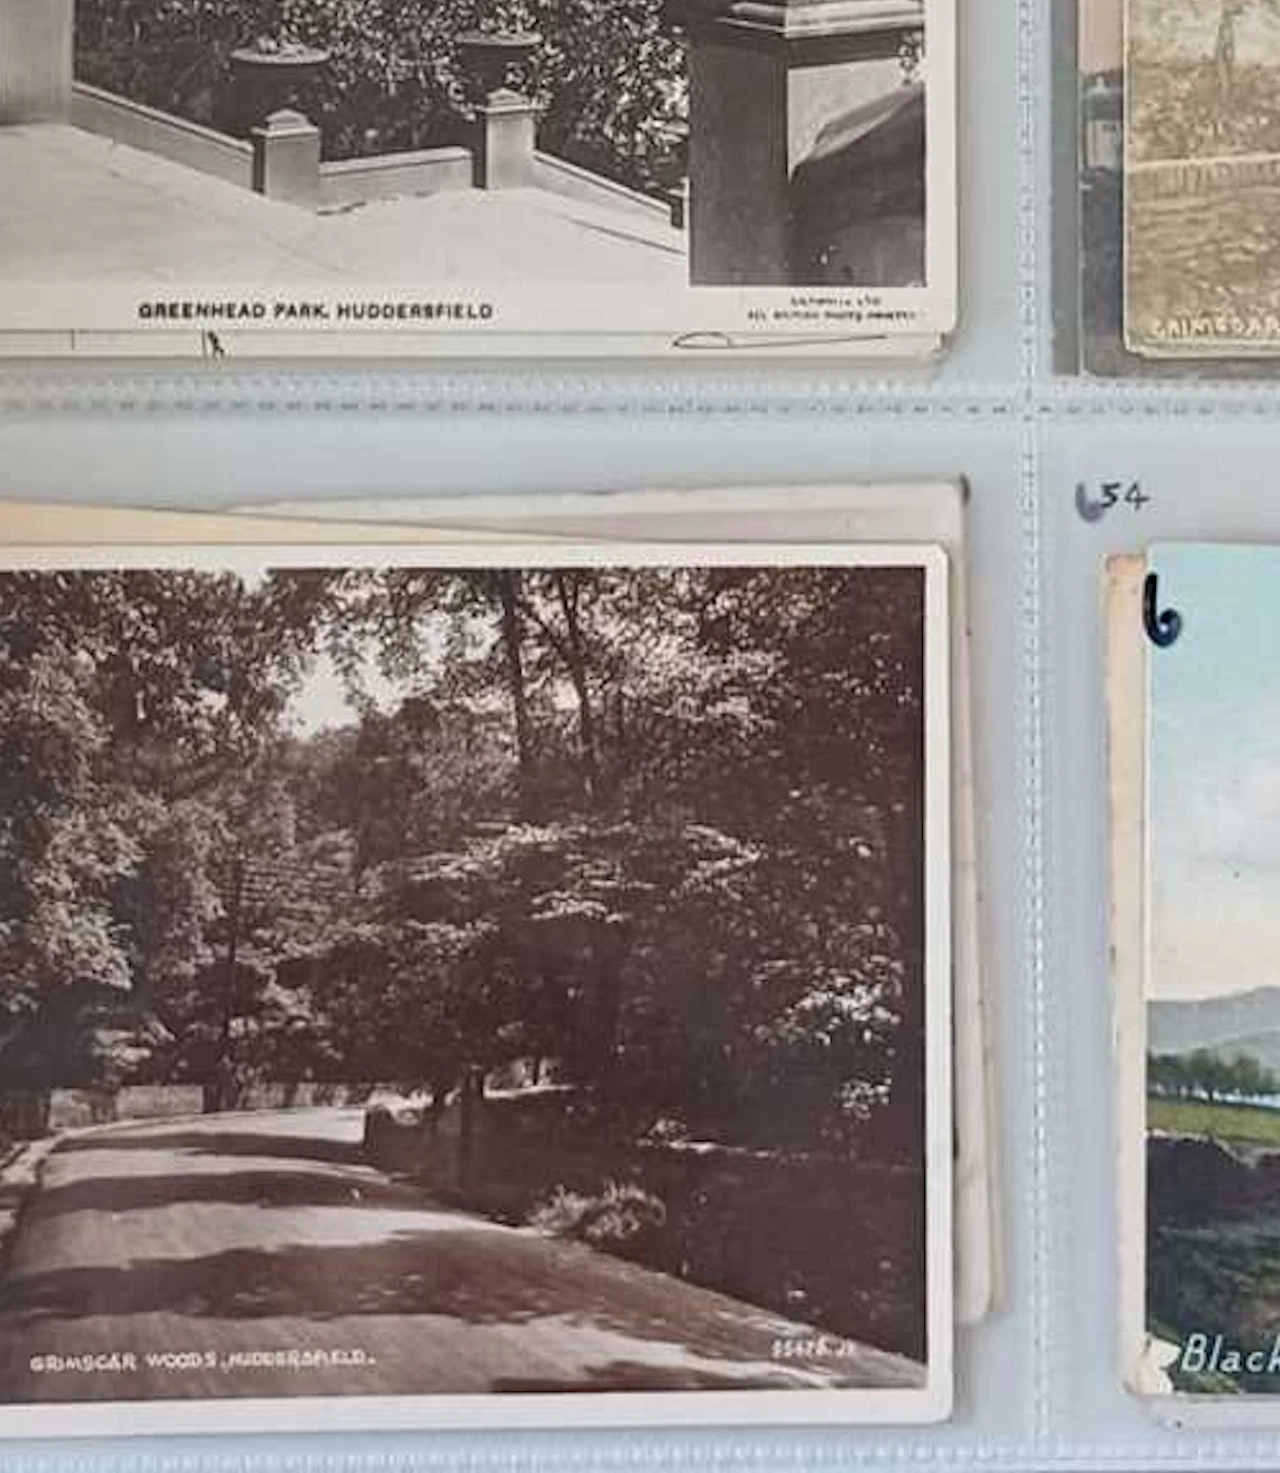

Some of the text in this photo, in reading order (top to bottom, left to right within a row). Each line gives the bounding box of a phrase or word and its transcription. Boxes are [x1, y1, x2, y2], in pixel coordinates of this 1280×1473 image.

[137, 302, 266, 320] GREENHEAD
[337, 302, 494, 321] HUDDERSFIELD
[1100, 481, 1150, 511] 54
[1142, 572, 1183, 649] 6
